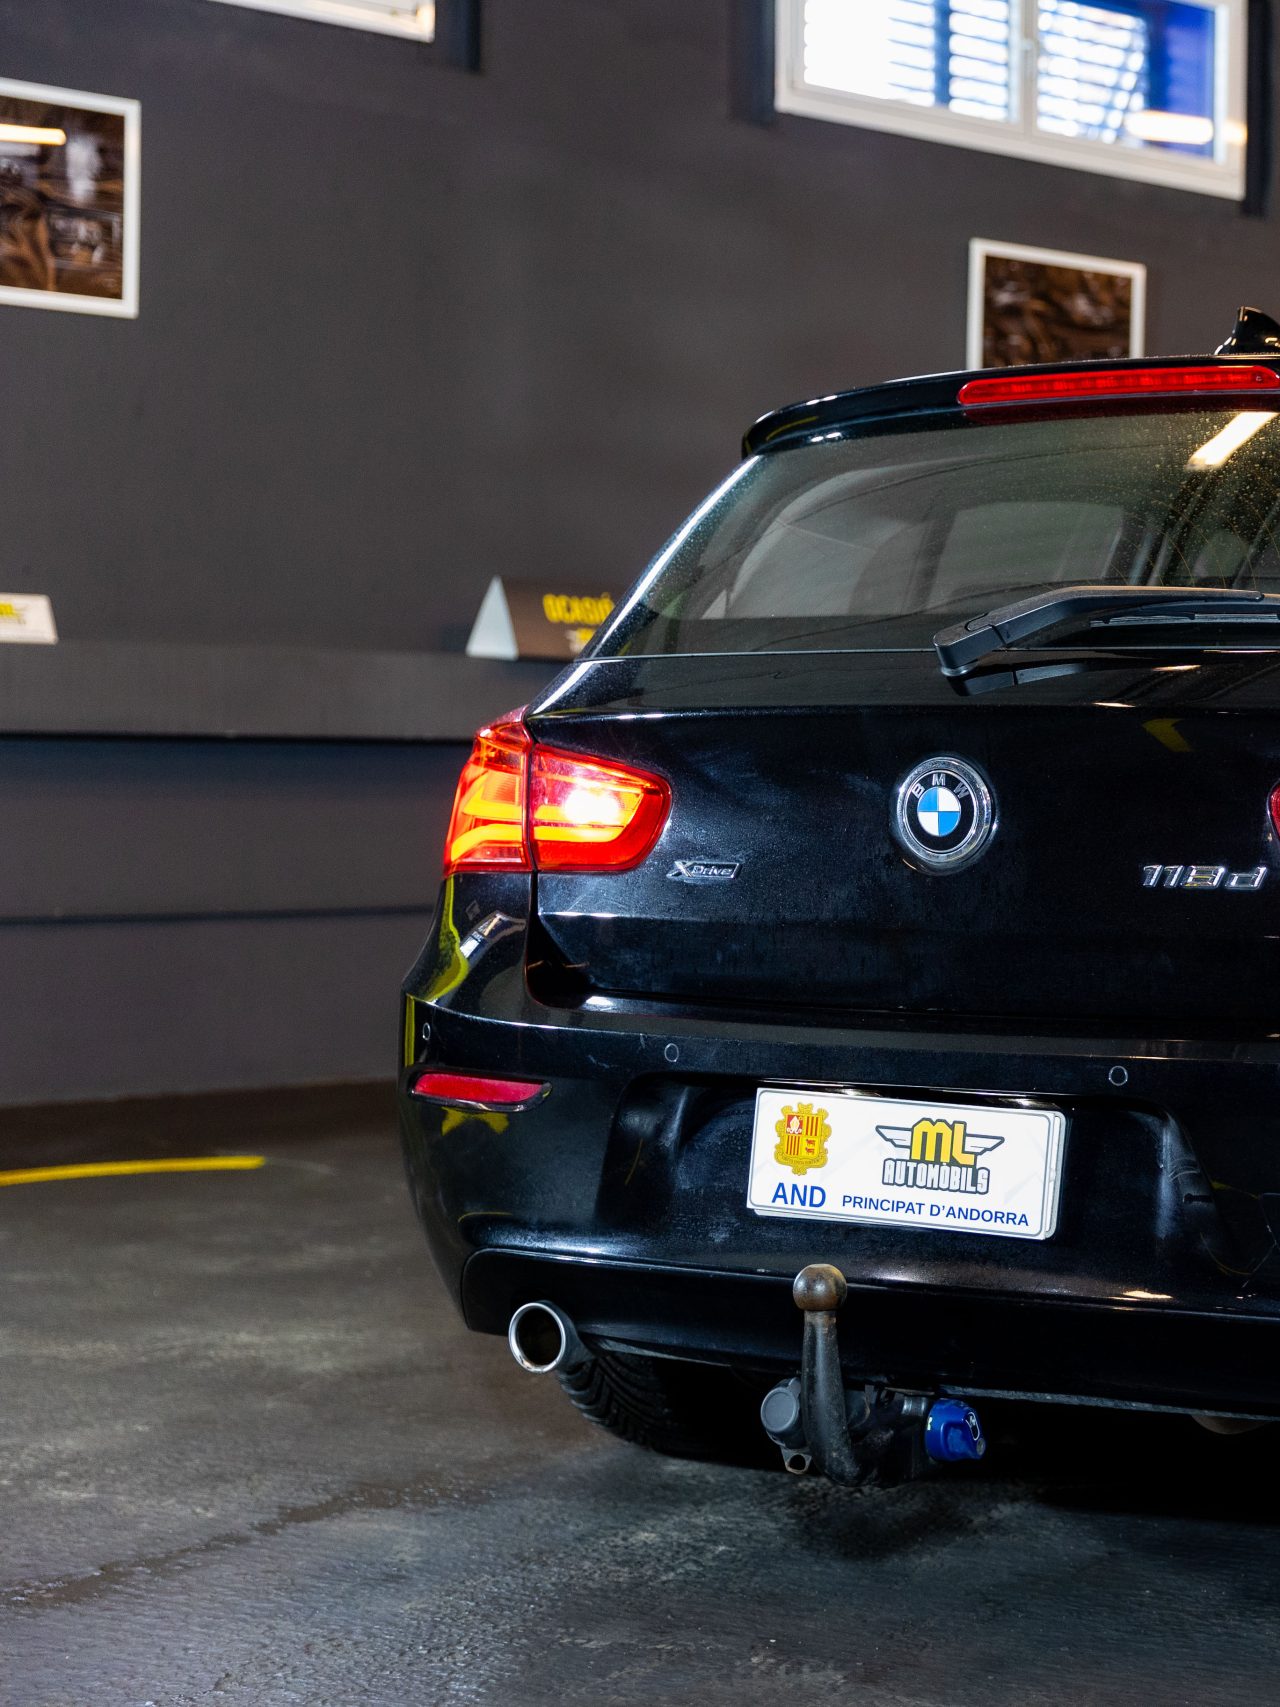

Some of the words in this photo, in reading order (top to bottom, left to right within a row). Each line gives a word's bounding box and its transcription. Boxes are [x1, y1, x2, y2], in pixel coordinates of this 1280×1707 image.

[911, 773, 970, 799] BMW
[1143, 864, 1268, 890] 118d
[910, 1118, 976, 1166] ML
[771, 1182, 826, 1208] AND
[842, 1195, 925, 1215] PRINCIPAT
[929, 1203, 1029, 1227] D'ANDORRA
